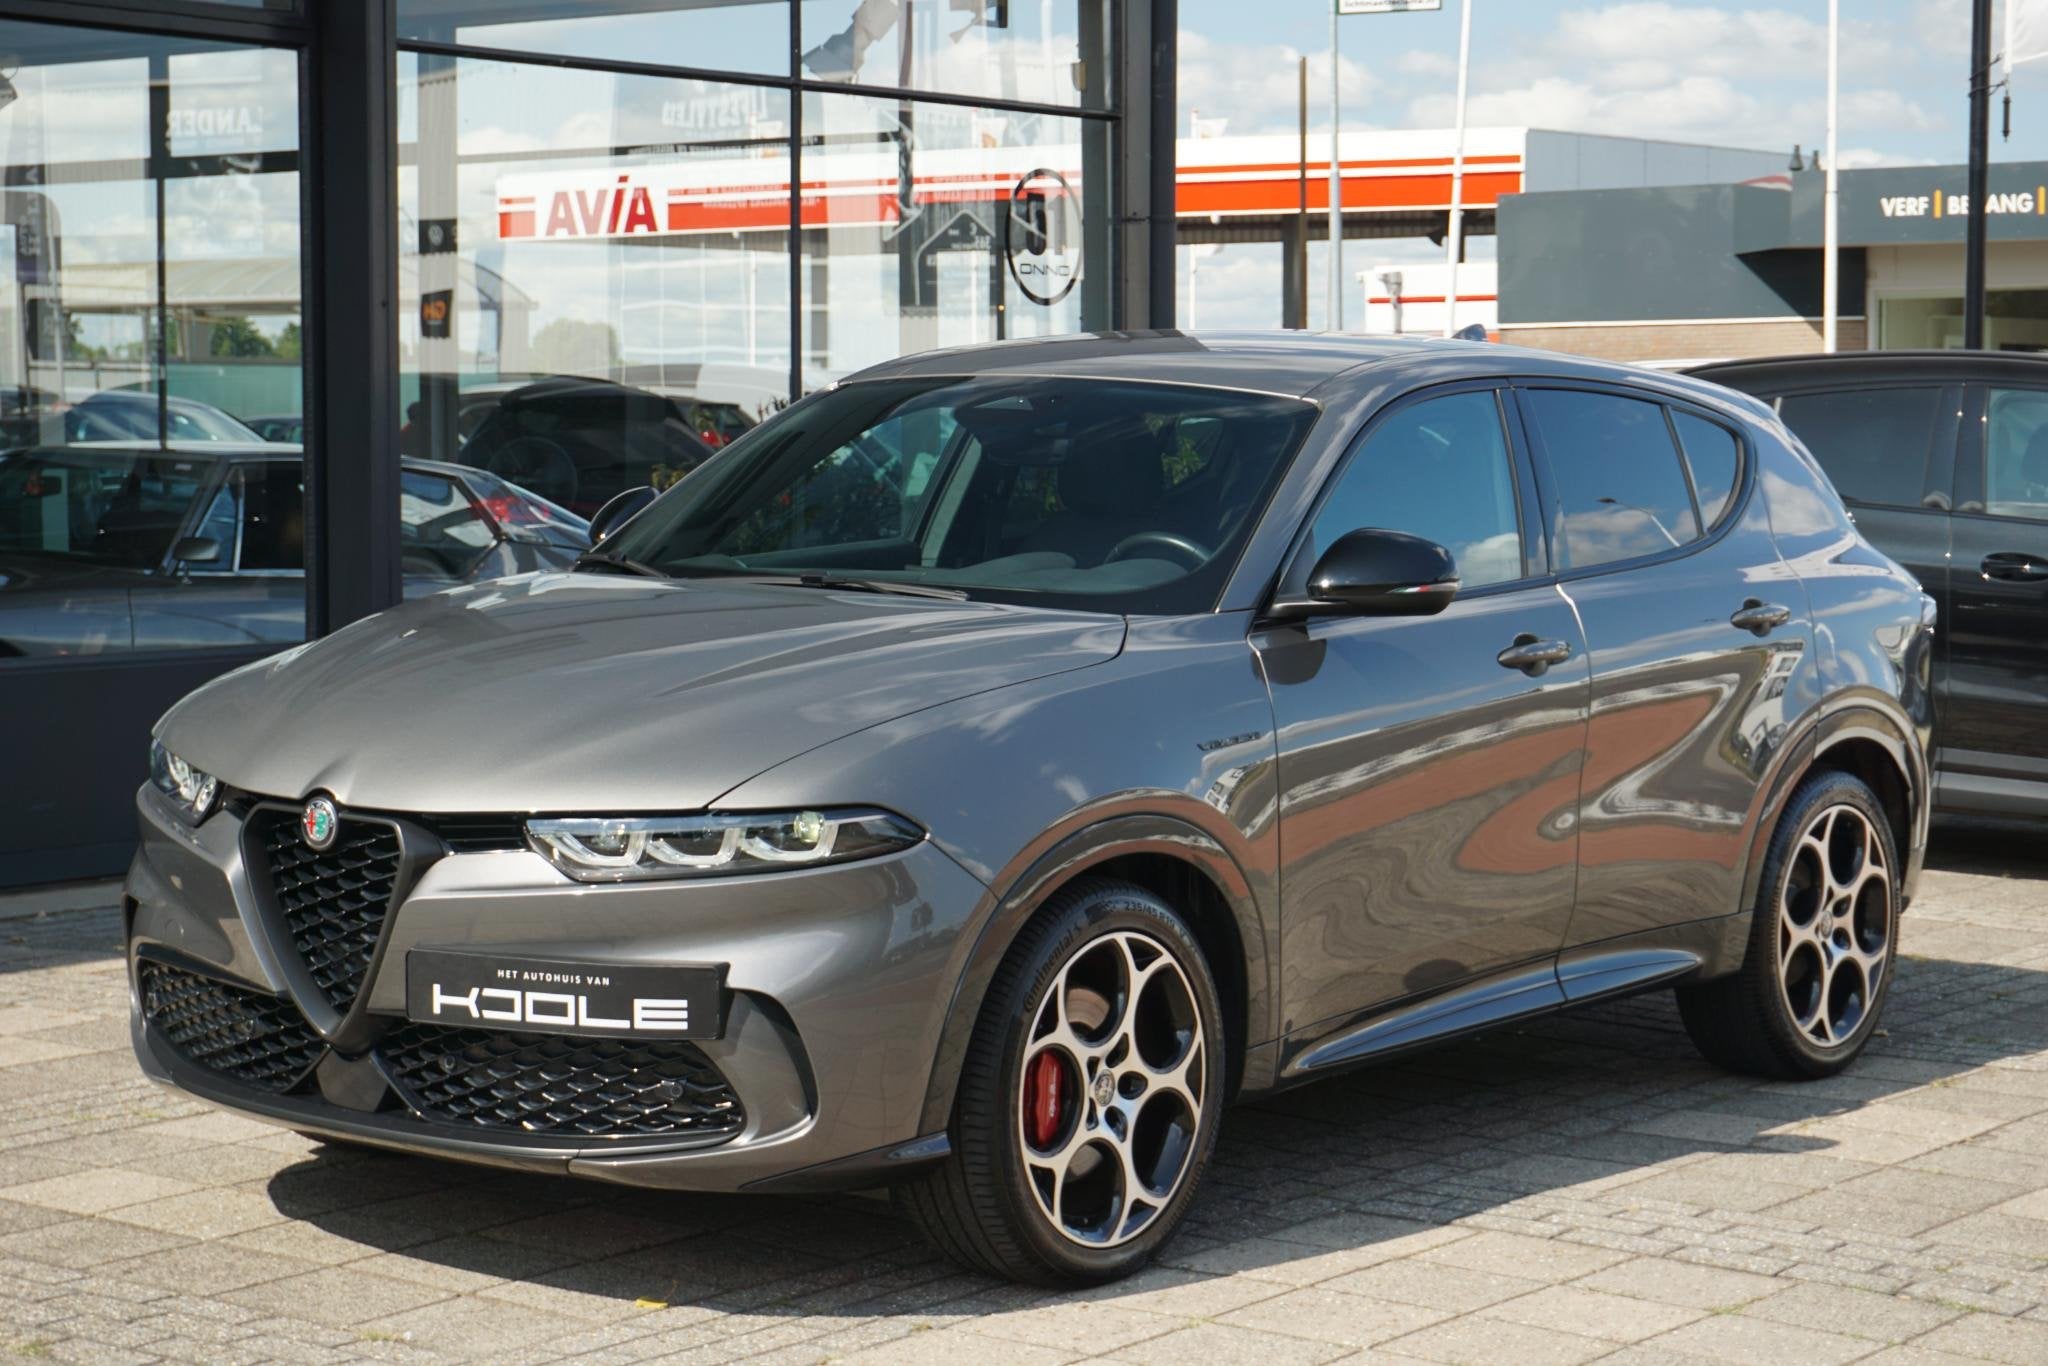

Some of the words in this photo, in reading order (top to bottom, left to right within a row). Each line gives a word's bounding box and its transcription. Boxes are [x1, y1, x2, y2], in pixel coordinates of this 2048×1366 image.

[1880, 196, 1929, 217] VERF
[1947, 193, 2034, 215] BEANG
[497, 968, 518, 980] HET
[523, 971, 582, 985] AUTOHUIS
[587, 976, 611, 986] VAN
